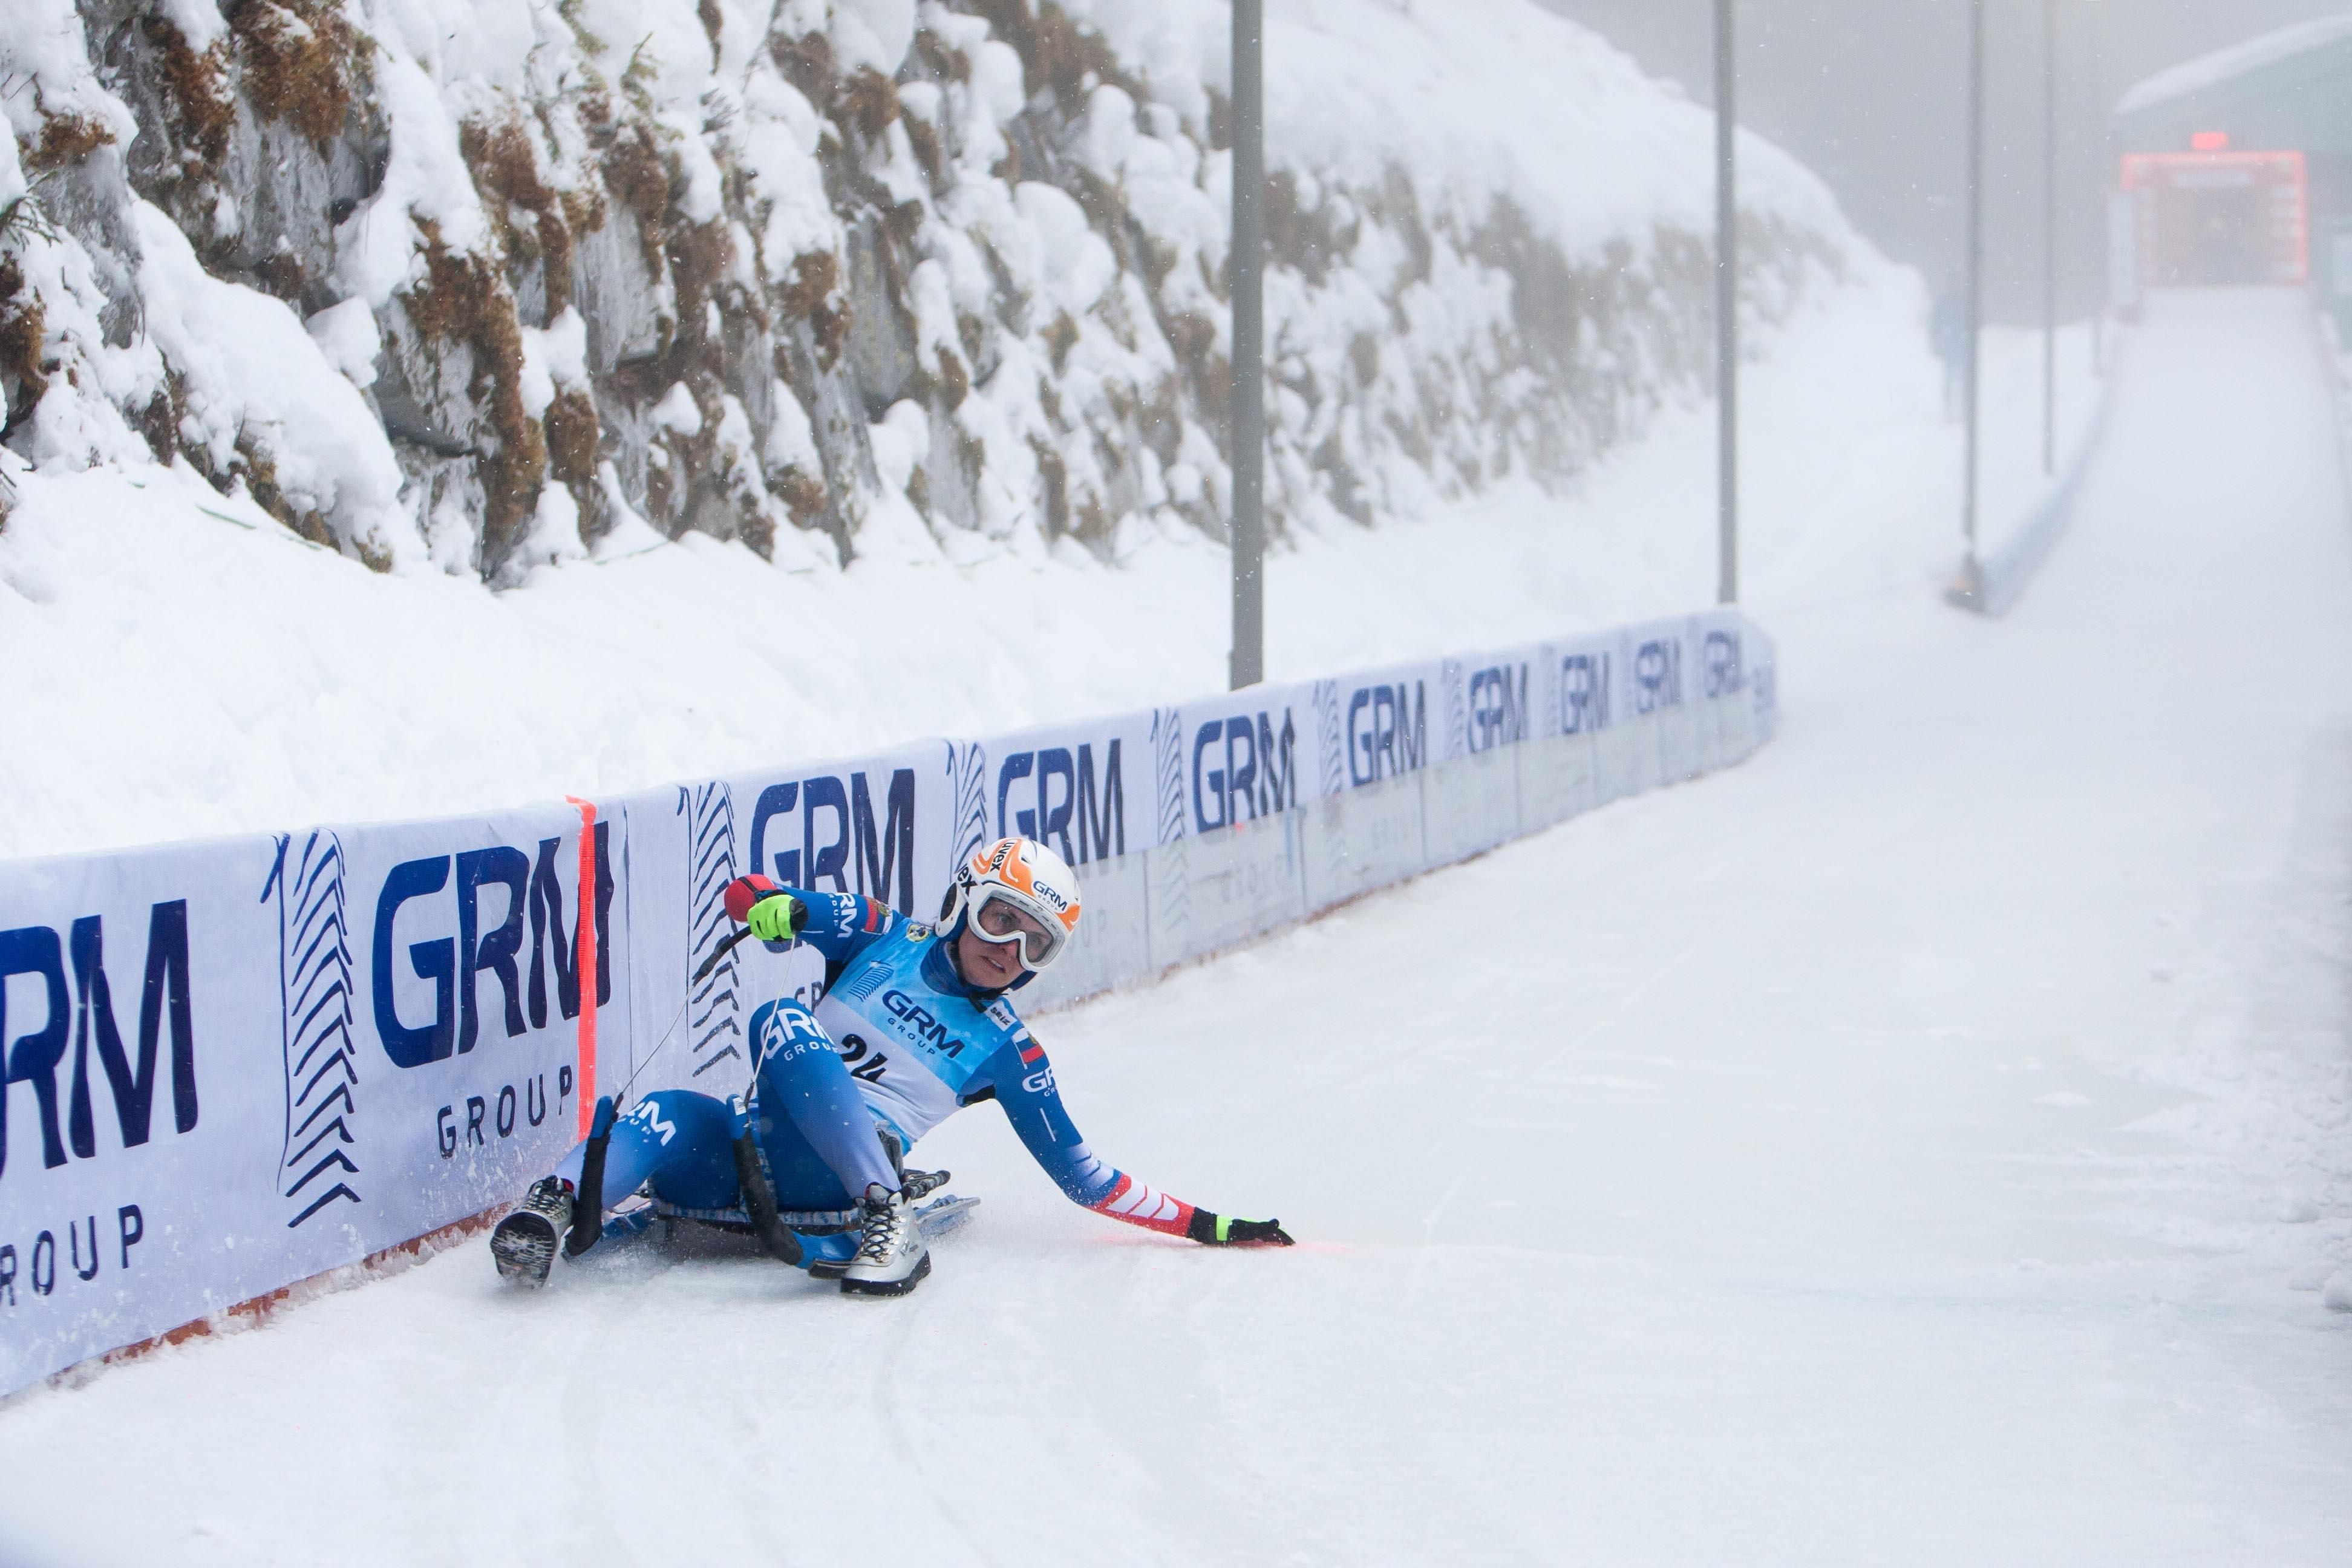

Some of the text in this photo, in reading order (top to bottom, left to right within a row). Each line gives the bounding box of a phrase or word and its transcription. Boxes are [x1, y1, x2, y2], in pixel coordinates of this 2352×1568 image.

[1347, 679, 1426, 786] GRM
[1468, 662, 1528, 754] GRM
[998, 738, 1125, 867] GRM
[1192, 706, 1295, 834] GRM
[990, 842, 1014, 872] uvex
[1033, 881, 1068, 911] GRM
[373, 821, 613, 1068] GRM
[835, 893, 857, 938] RM
[0, 898, 198, 1169] RM
[882, 990, 965, 1059] GRM
[887, 1018, 935, 1055] GROUP
[437, 1065, 572, 1158] GROUP
[0, 1204, 143, 1306] ROUP
